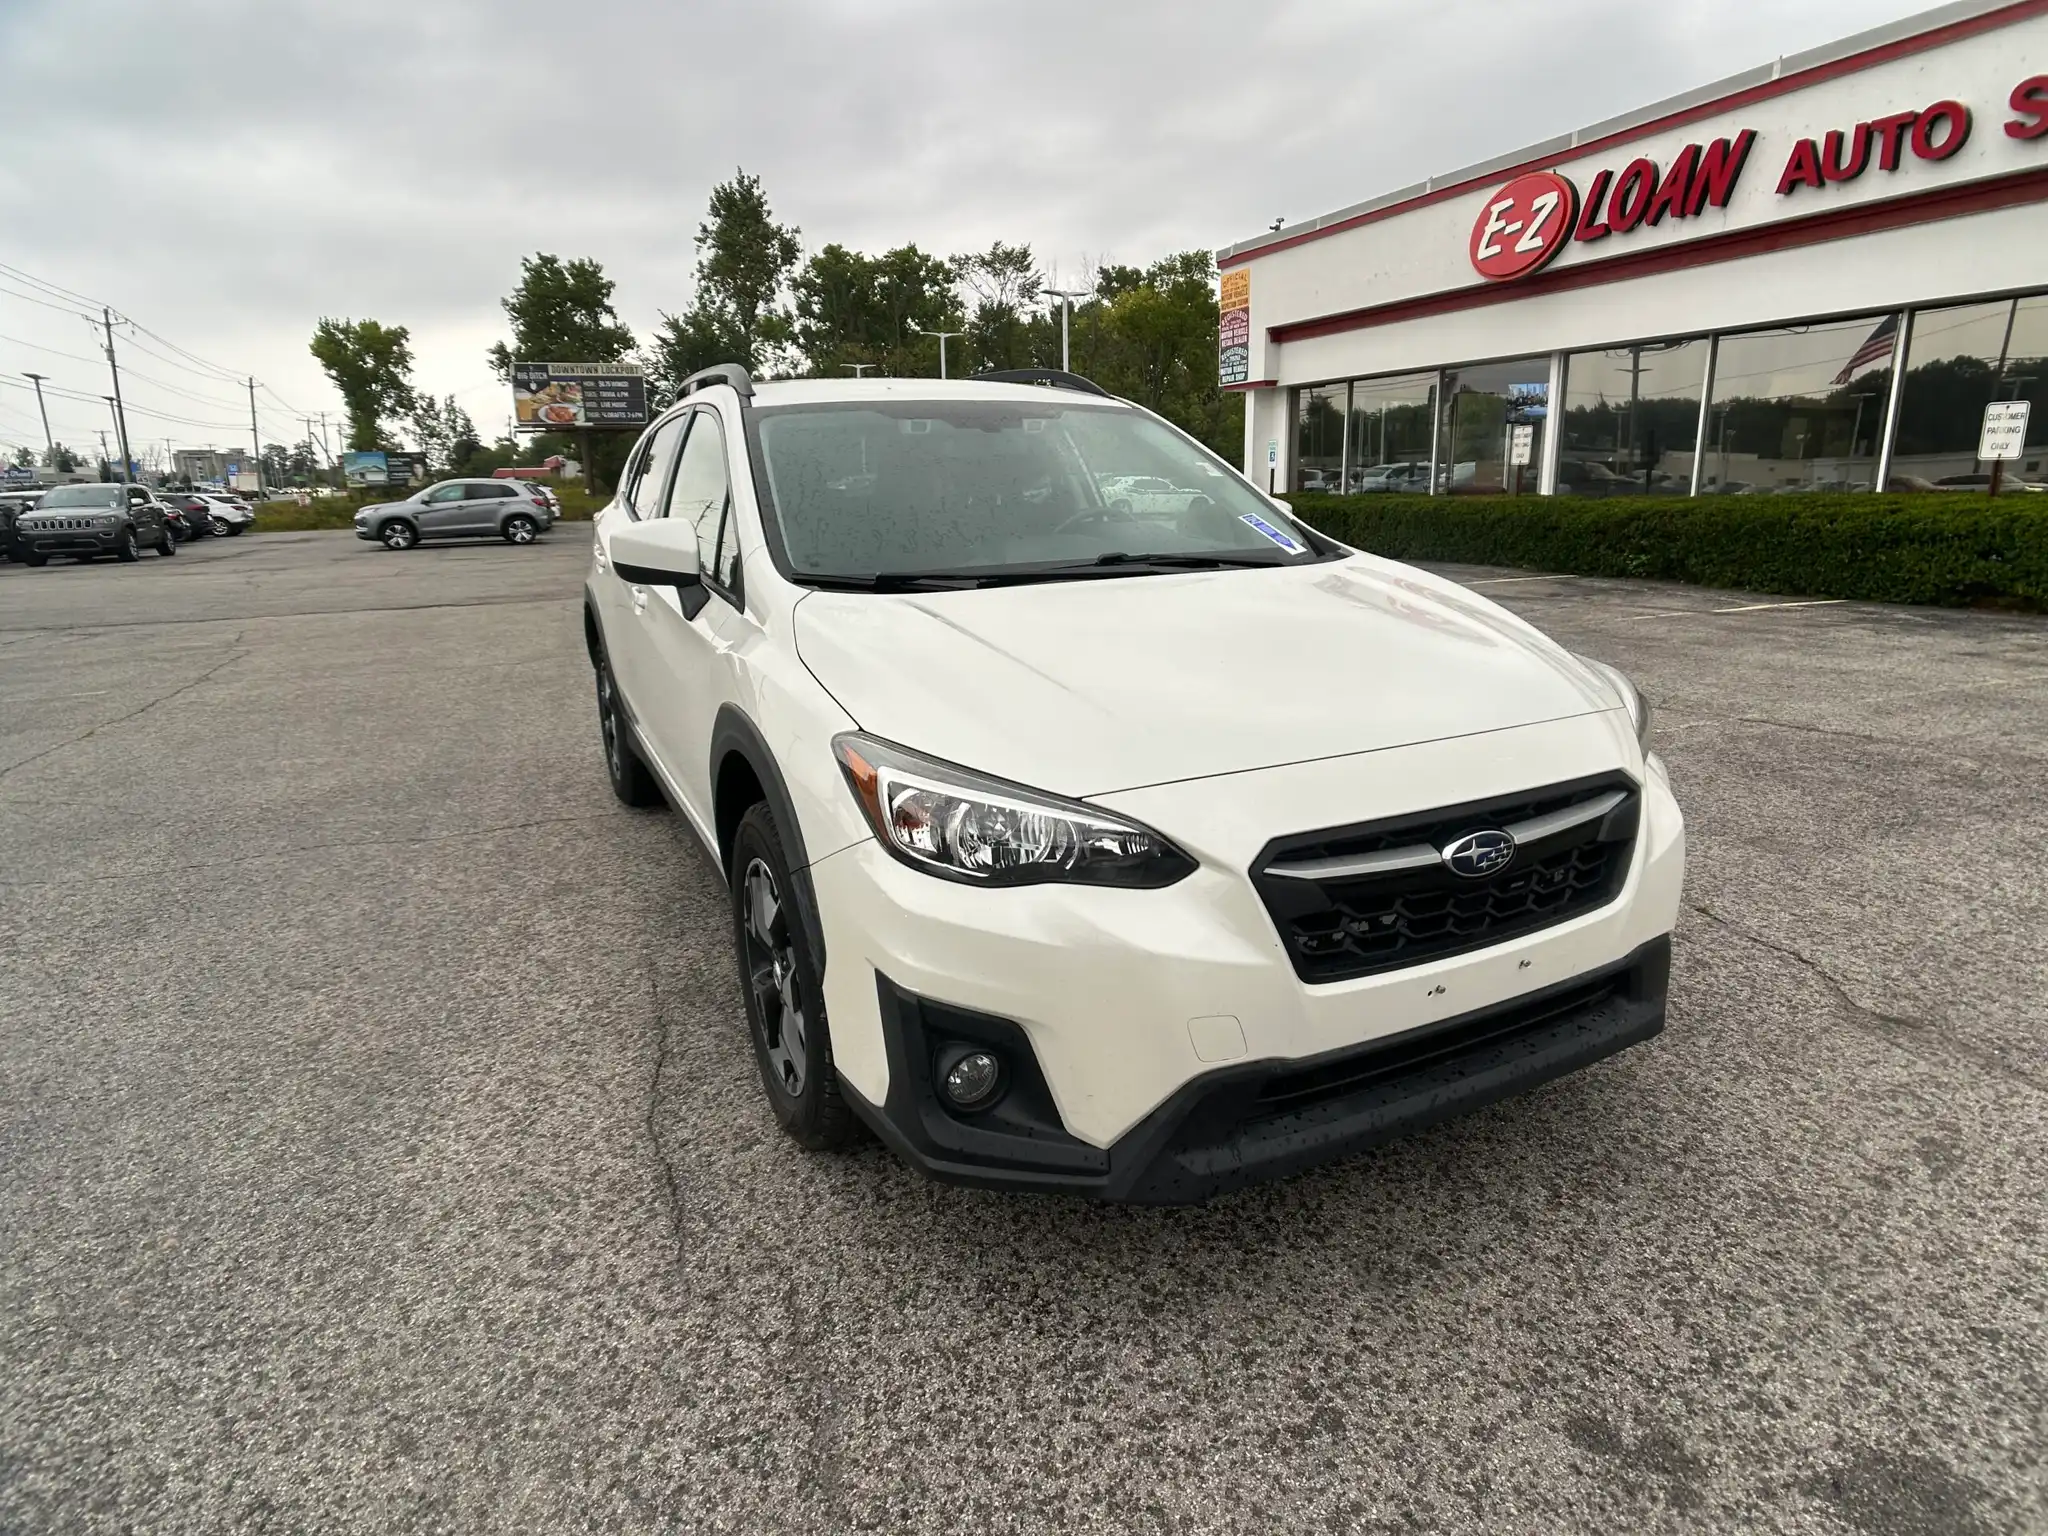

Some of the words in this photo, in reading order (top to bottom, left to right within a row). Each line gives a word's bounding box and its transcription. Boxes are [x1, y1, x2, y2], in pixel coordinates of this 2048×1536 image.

[1477, 190, 1559, 260] E-Z
[1574, 129, 1757, 242] LOAN
[1776, 99, 1973, 195] AUTO
[1221, 310, 1248, 326] REGISTERED
[1221, 346, 1248, 362] REGISTERED
[551, 365, 598, 375] DOWNTOWN
[601, 366, 639, 375] LOCKPORT
[1990, 442, 2010, 450] ONLY
